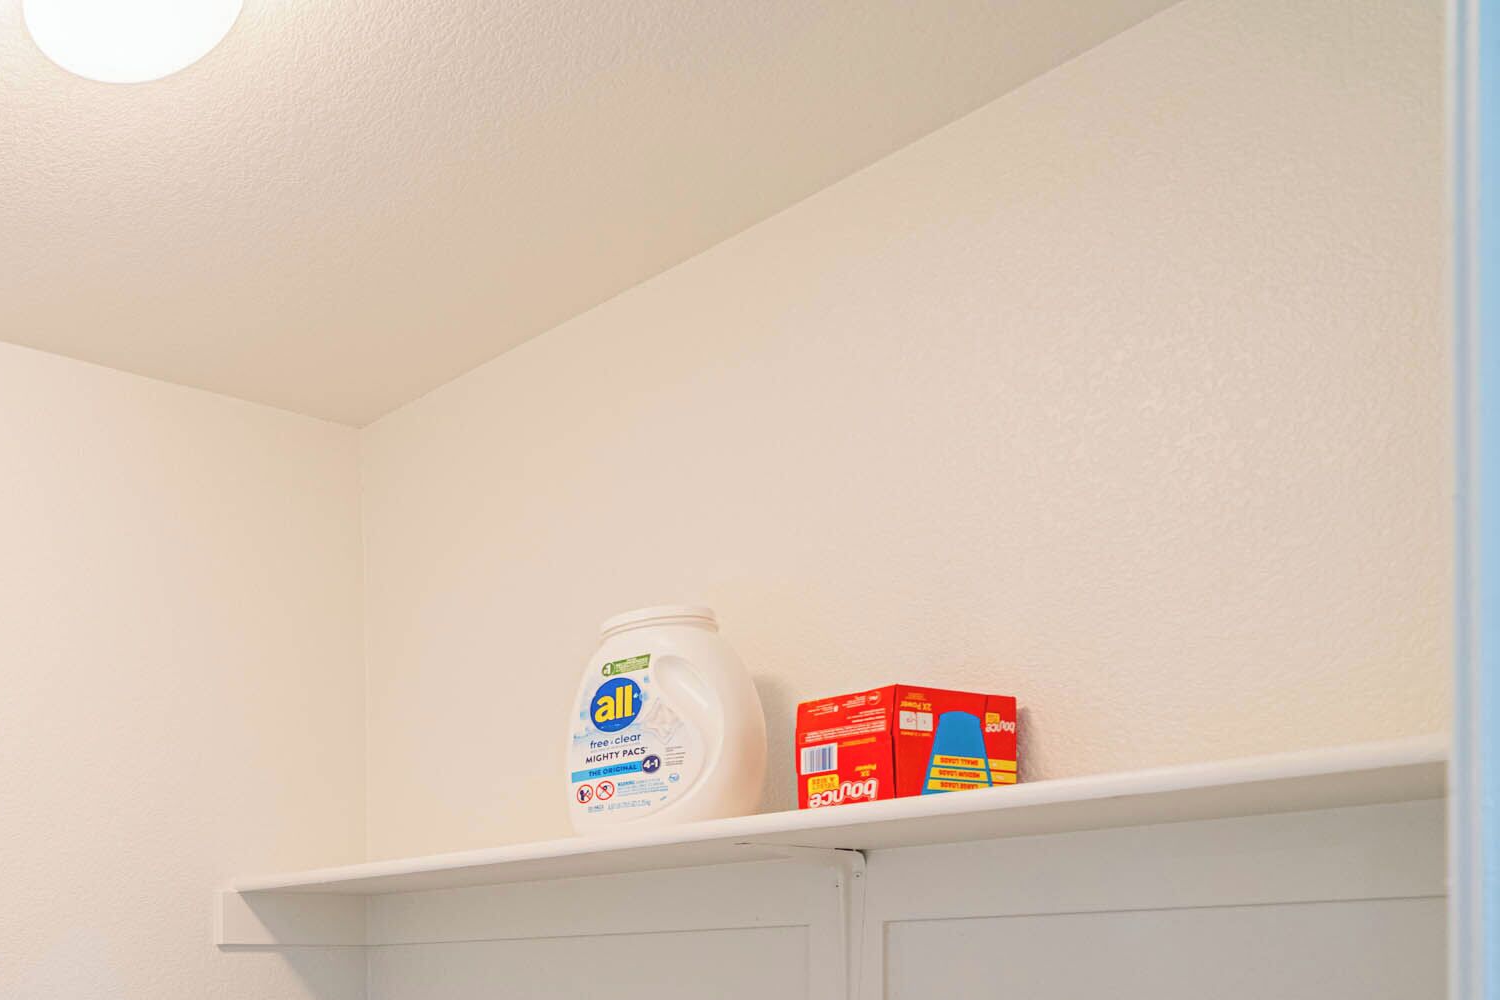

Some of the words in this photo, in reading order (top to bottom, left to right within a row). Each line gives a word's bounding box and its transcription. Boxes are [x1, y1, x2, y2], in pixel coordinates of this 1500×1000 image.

[594, 684, 633, 723] all
[985, 720, 1016, 733] bounce
[590, 739, 610, 749] free
[614, 733, 641, 745] clear
[585, 751, 620, 764] MIGHTY
[939, 757, 959, 765] LOADS
[588, 769, 601, 777] THE
[603, 764, 638, 775] ORIGINAL
[808, 778, 878, 809] bounce
